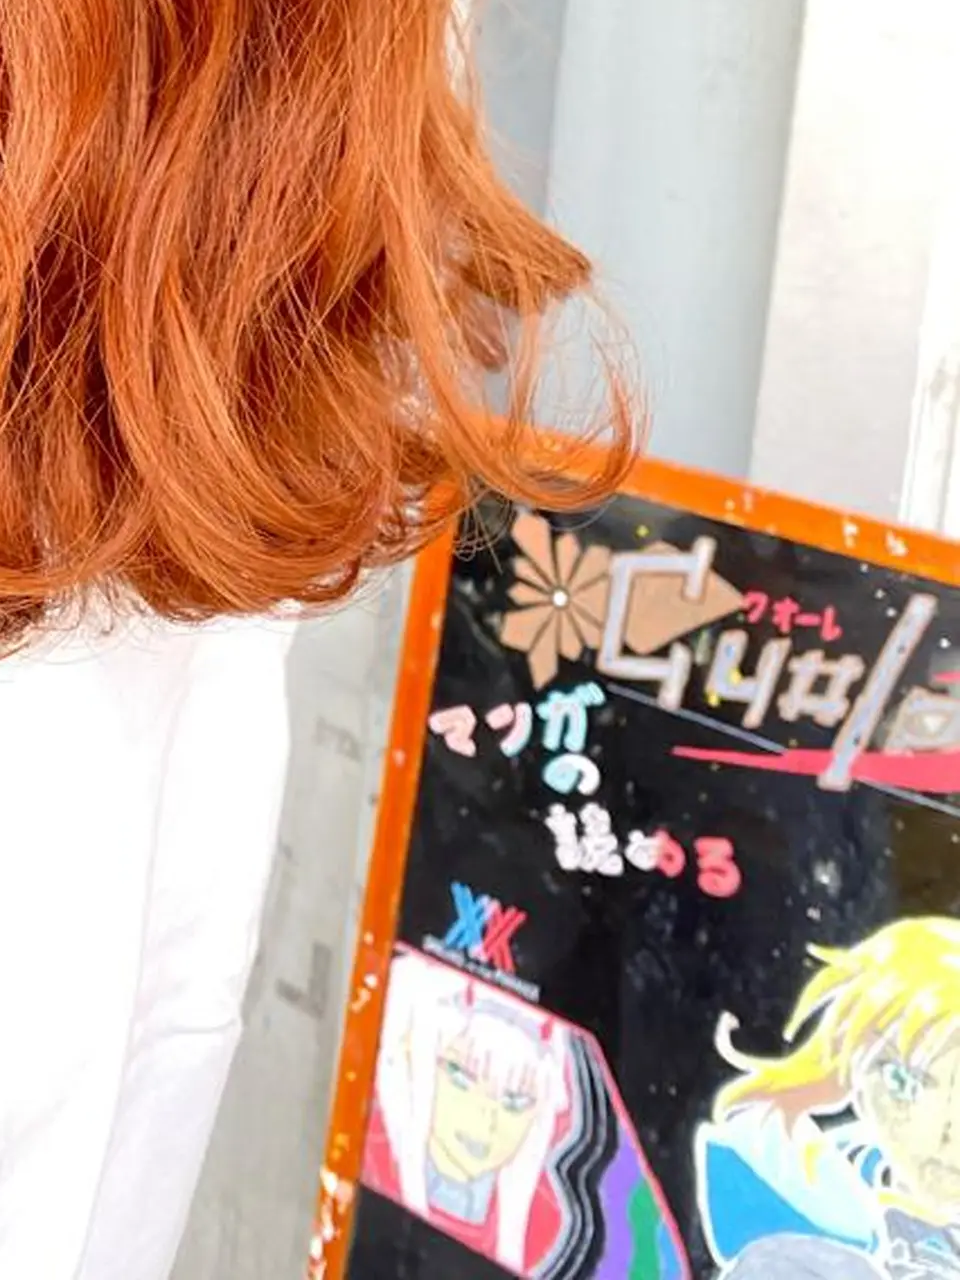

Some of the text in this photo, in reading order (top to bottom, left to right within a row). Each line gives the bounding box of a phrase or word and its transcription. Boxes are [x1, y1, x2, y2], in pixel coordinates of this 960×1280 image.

[428, 682, 606, 758] マンガ
[543, 753, 601, 796] の
